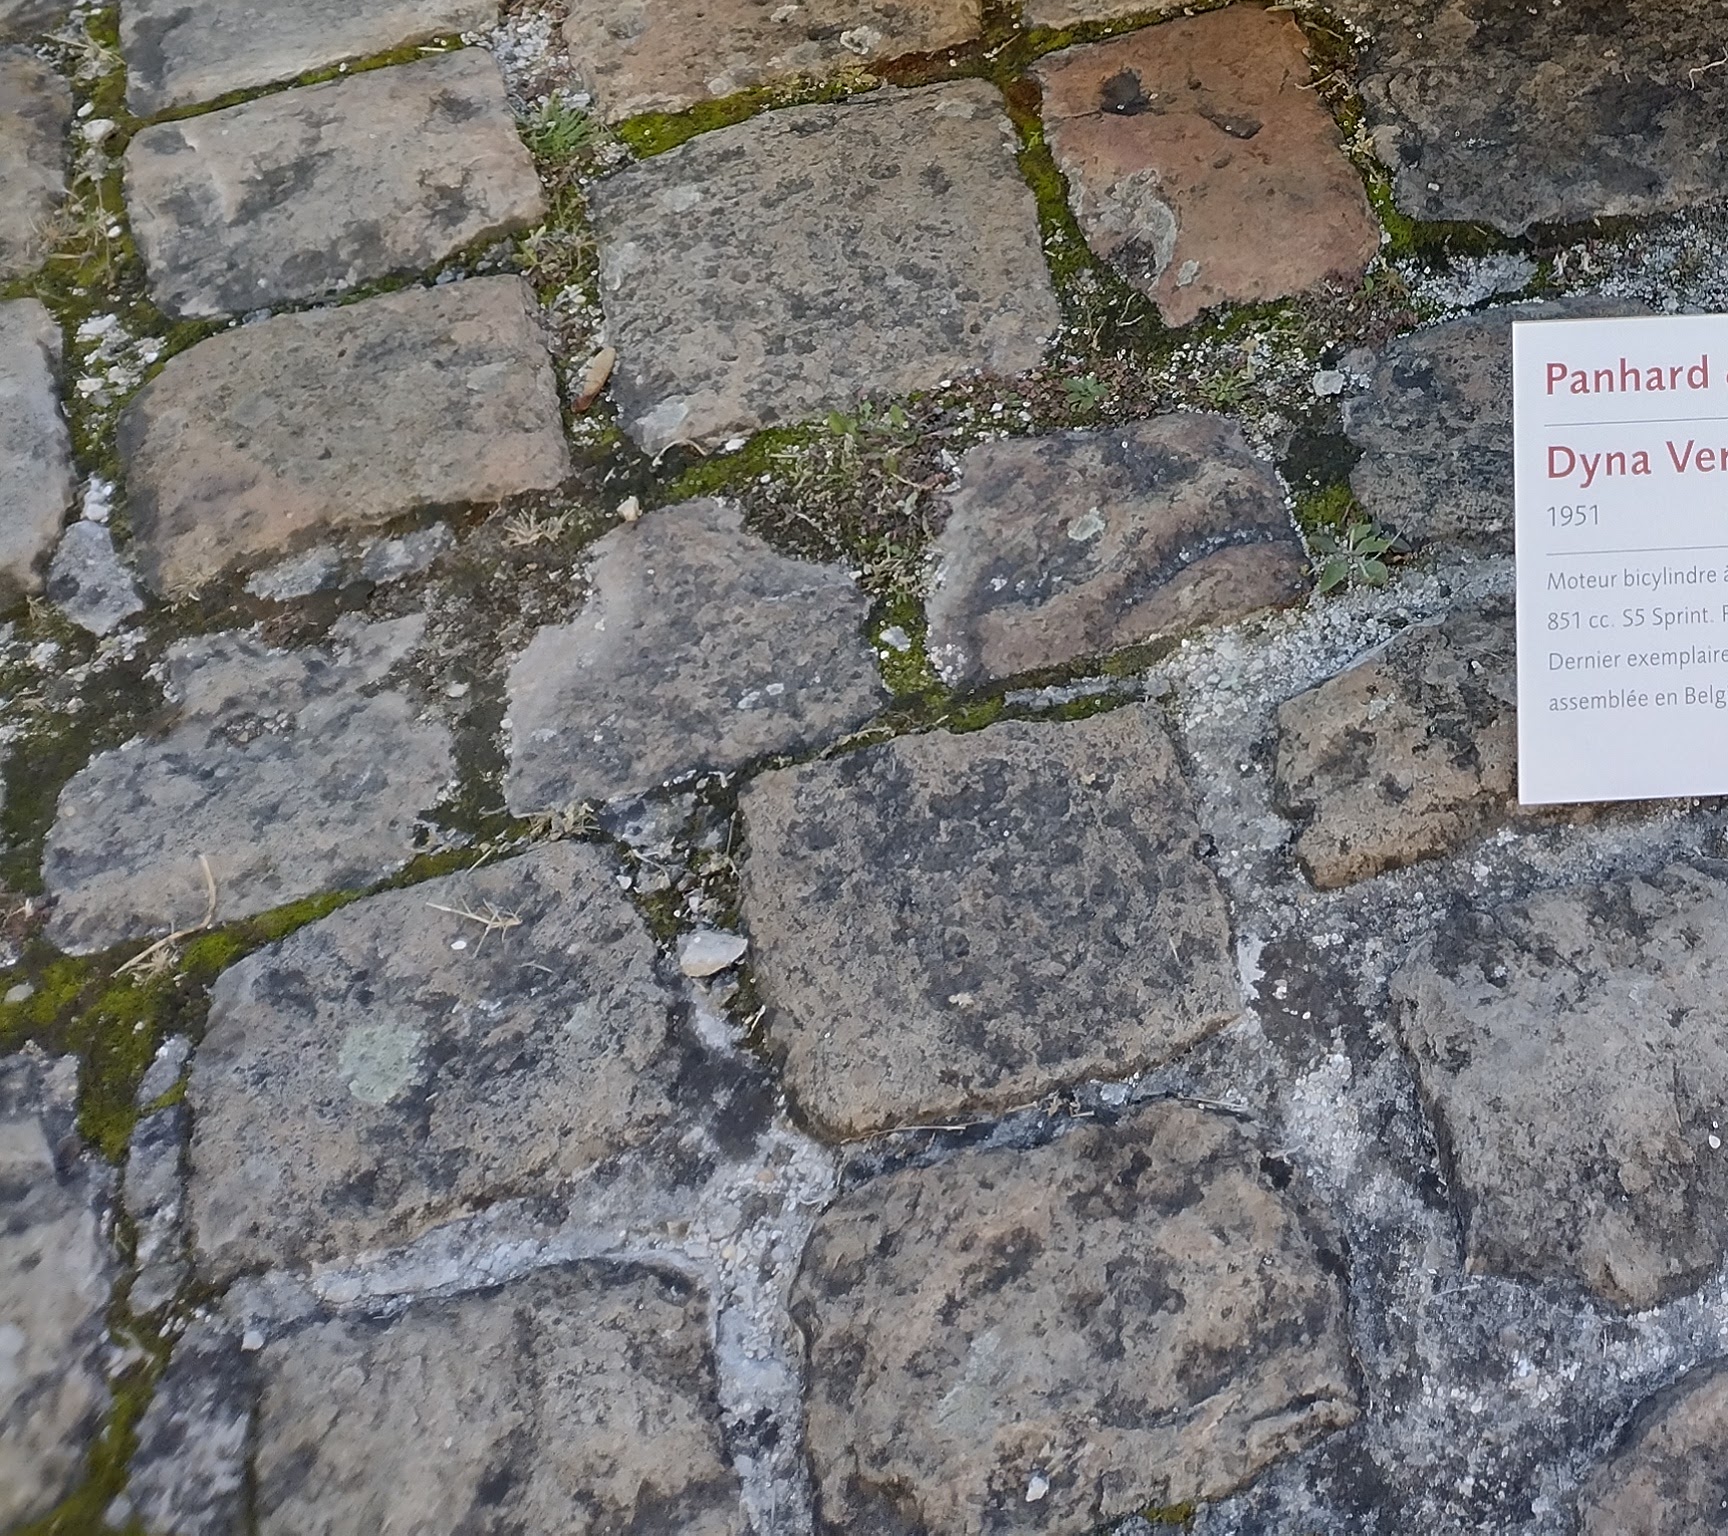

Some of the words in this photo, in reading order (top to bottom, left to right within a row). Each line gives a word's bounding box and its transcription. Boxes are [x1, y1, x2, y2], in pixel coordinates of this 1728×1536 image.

[1546, 353, 1709, 395] Panhard
[1547, 445, 1653, 489] Dyna
[1546, 504, 1600, 528] 1951
[1547, 571, 1618, 591] Moteur
[1623, 563, 1718, 592] bicylindre
[1547, 611, 1581, 631] 851
[1588, 614, 1615, 629] cc.
[1622, 608, 1645, 628] S5
[1651, 605, 1715, 632] Sprint.
[1548, 650, 1622, 671] Dernier
[1548, 688, 1649, 712] assemblée
[1654, 691, 1678, 707] en
